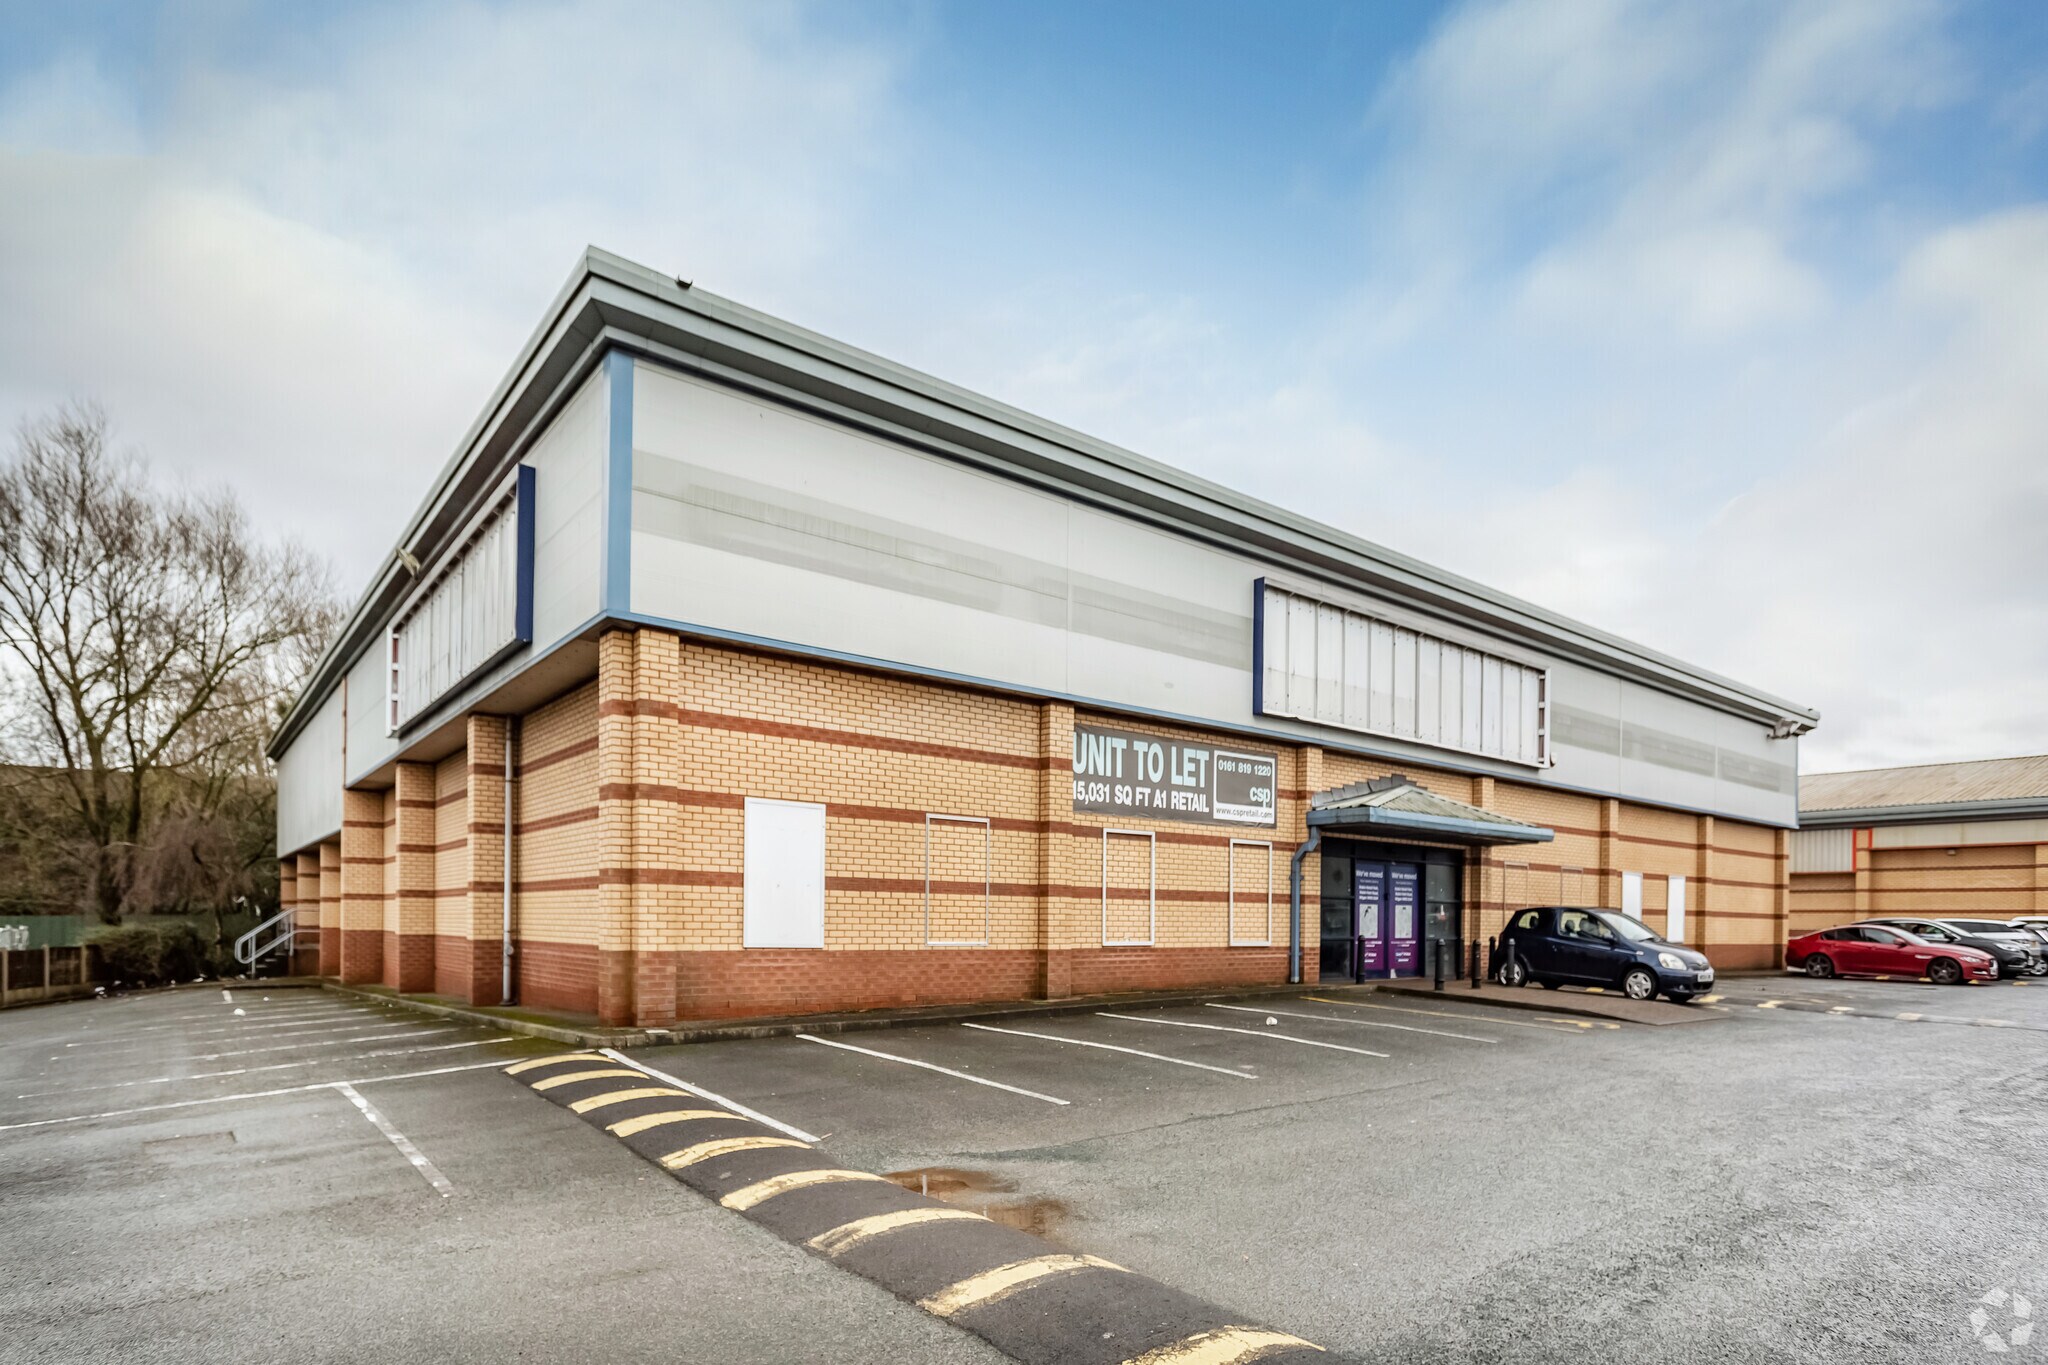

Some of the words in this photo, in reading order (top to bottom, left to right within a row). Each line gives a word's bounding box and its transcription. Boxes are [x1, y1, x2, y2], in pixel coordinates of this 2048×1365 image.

[1072, 732, 1127, 778] UNIT
[1133, 740, 1164, 784] TO
[1171, 746, 1209, 788] LET
[1218, 759, 1236, 772] 0161
[1238, 762, 1252, 774] 819
[1254, 764, 1272, 777] 1220
[1073, 780, 1110, 805] 15,031
[1114, 783, 1132, 806] SQ
[1135, 786, 1151, 807] FT
[1153, 788, 1167, 809] A1
[1170, 790, 1209, 813] RETAIL
[1249, 786, 1271, 808] csp
[1216, 807, 1273, 819] www.cspretail.com
